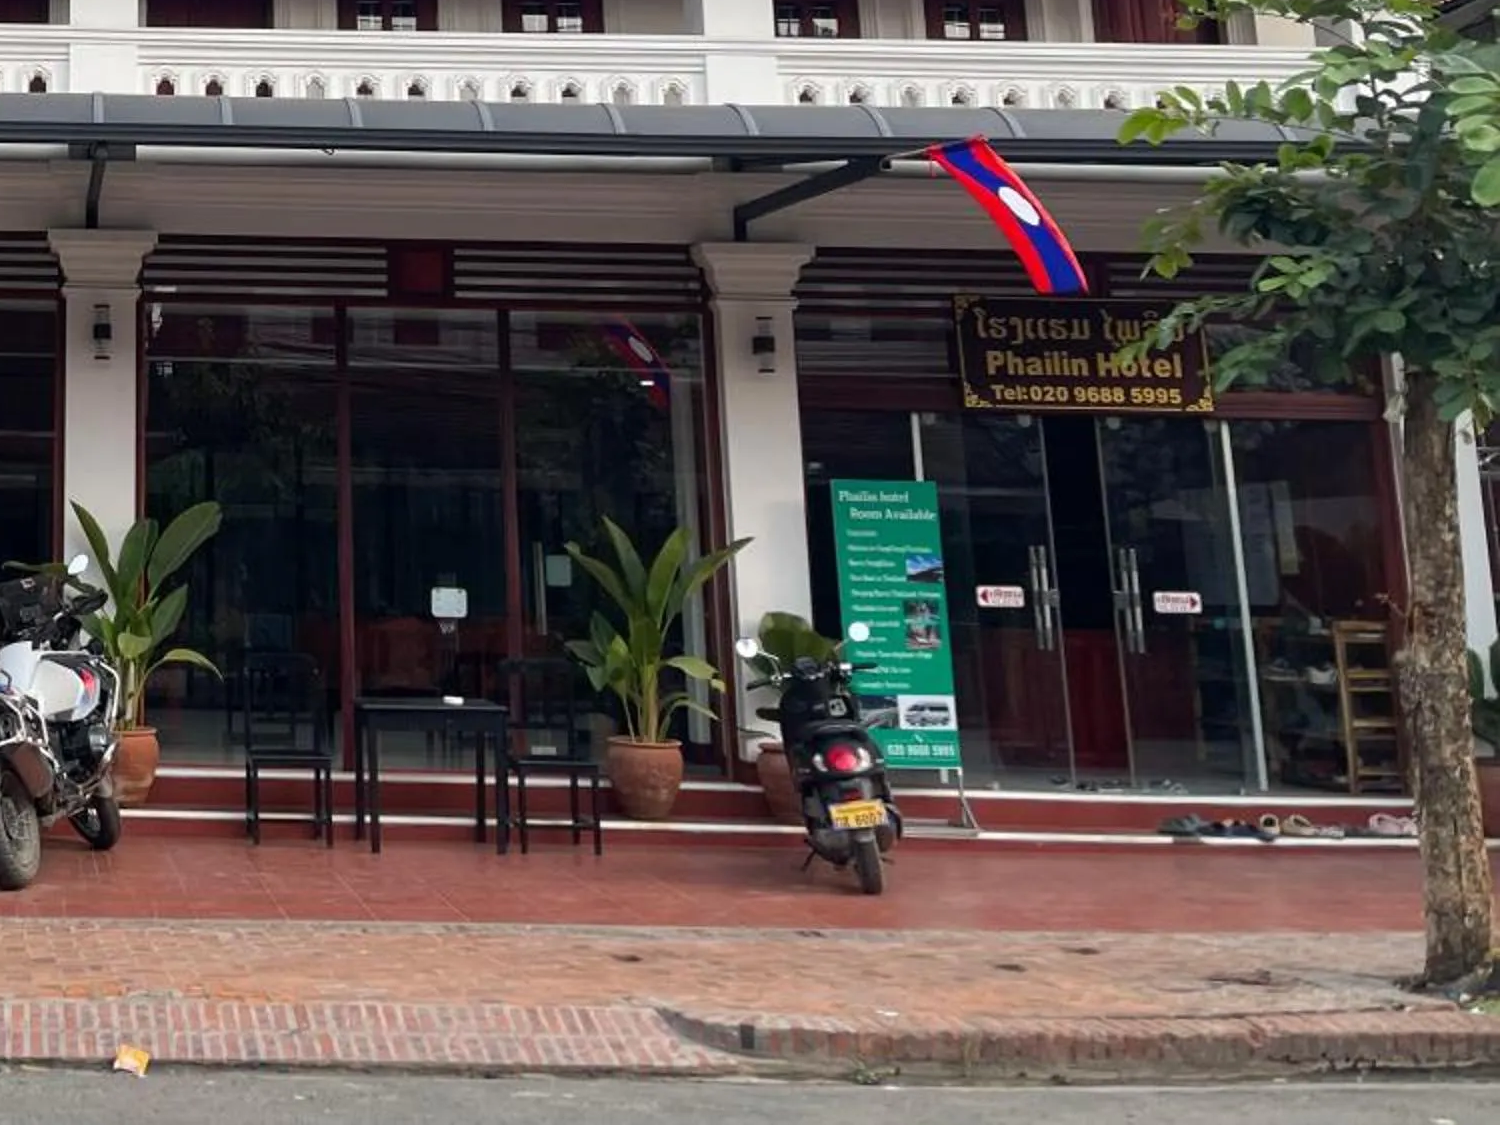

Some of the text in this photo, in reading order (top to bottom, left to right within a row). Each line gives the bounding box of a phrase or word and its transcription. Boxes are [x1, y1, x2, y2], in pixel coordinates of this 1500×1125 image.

[986, 350, 1183, 378] Phailin Hotel
[1073, 386, 1125, 403] 9688
[1131, 388, 1182, 404] 5995
[849, 506, 937, 521] Room Available
